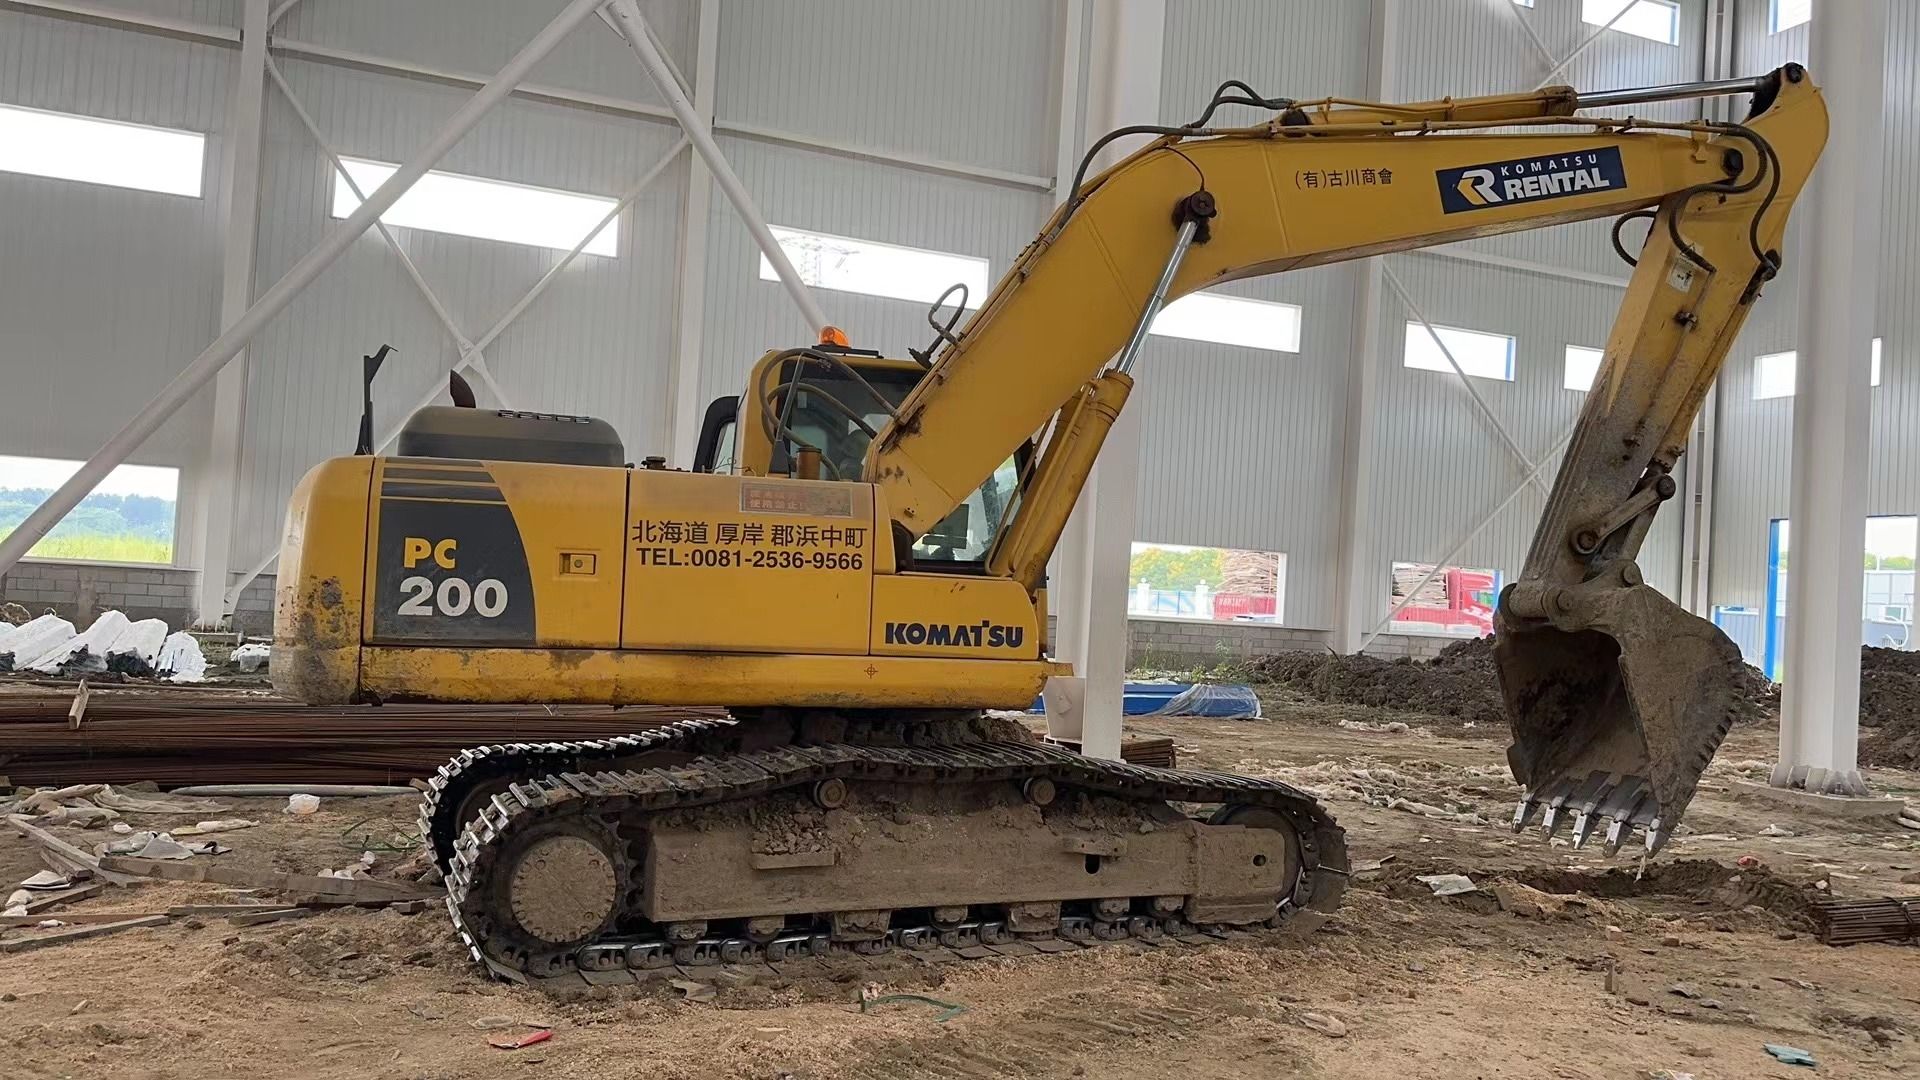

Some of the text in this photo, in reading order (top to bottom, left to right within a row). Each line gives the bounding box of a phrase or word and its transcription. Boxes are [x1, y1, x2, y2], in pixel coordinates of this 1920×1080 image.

[1501, 154, 1597, 176] KOMATSU
[1504, 167, 1610, 200] RENTAL
[403, 537, 457, 569] PC
[636, 548, 863, 570] TEL:0081-2536-9566
[398, 576, 508, 617] 200
[884, 620, 1023, 648] KOMATSU
